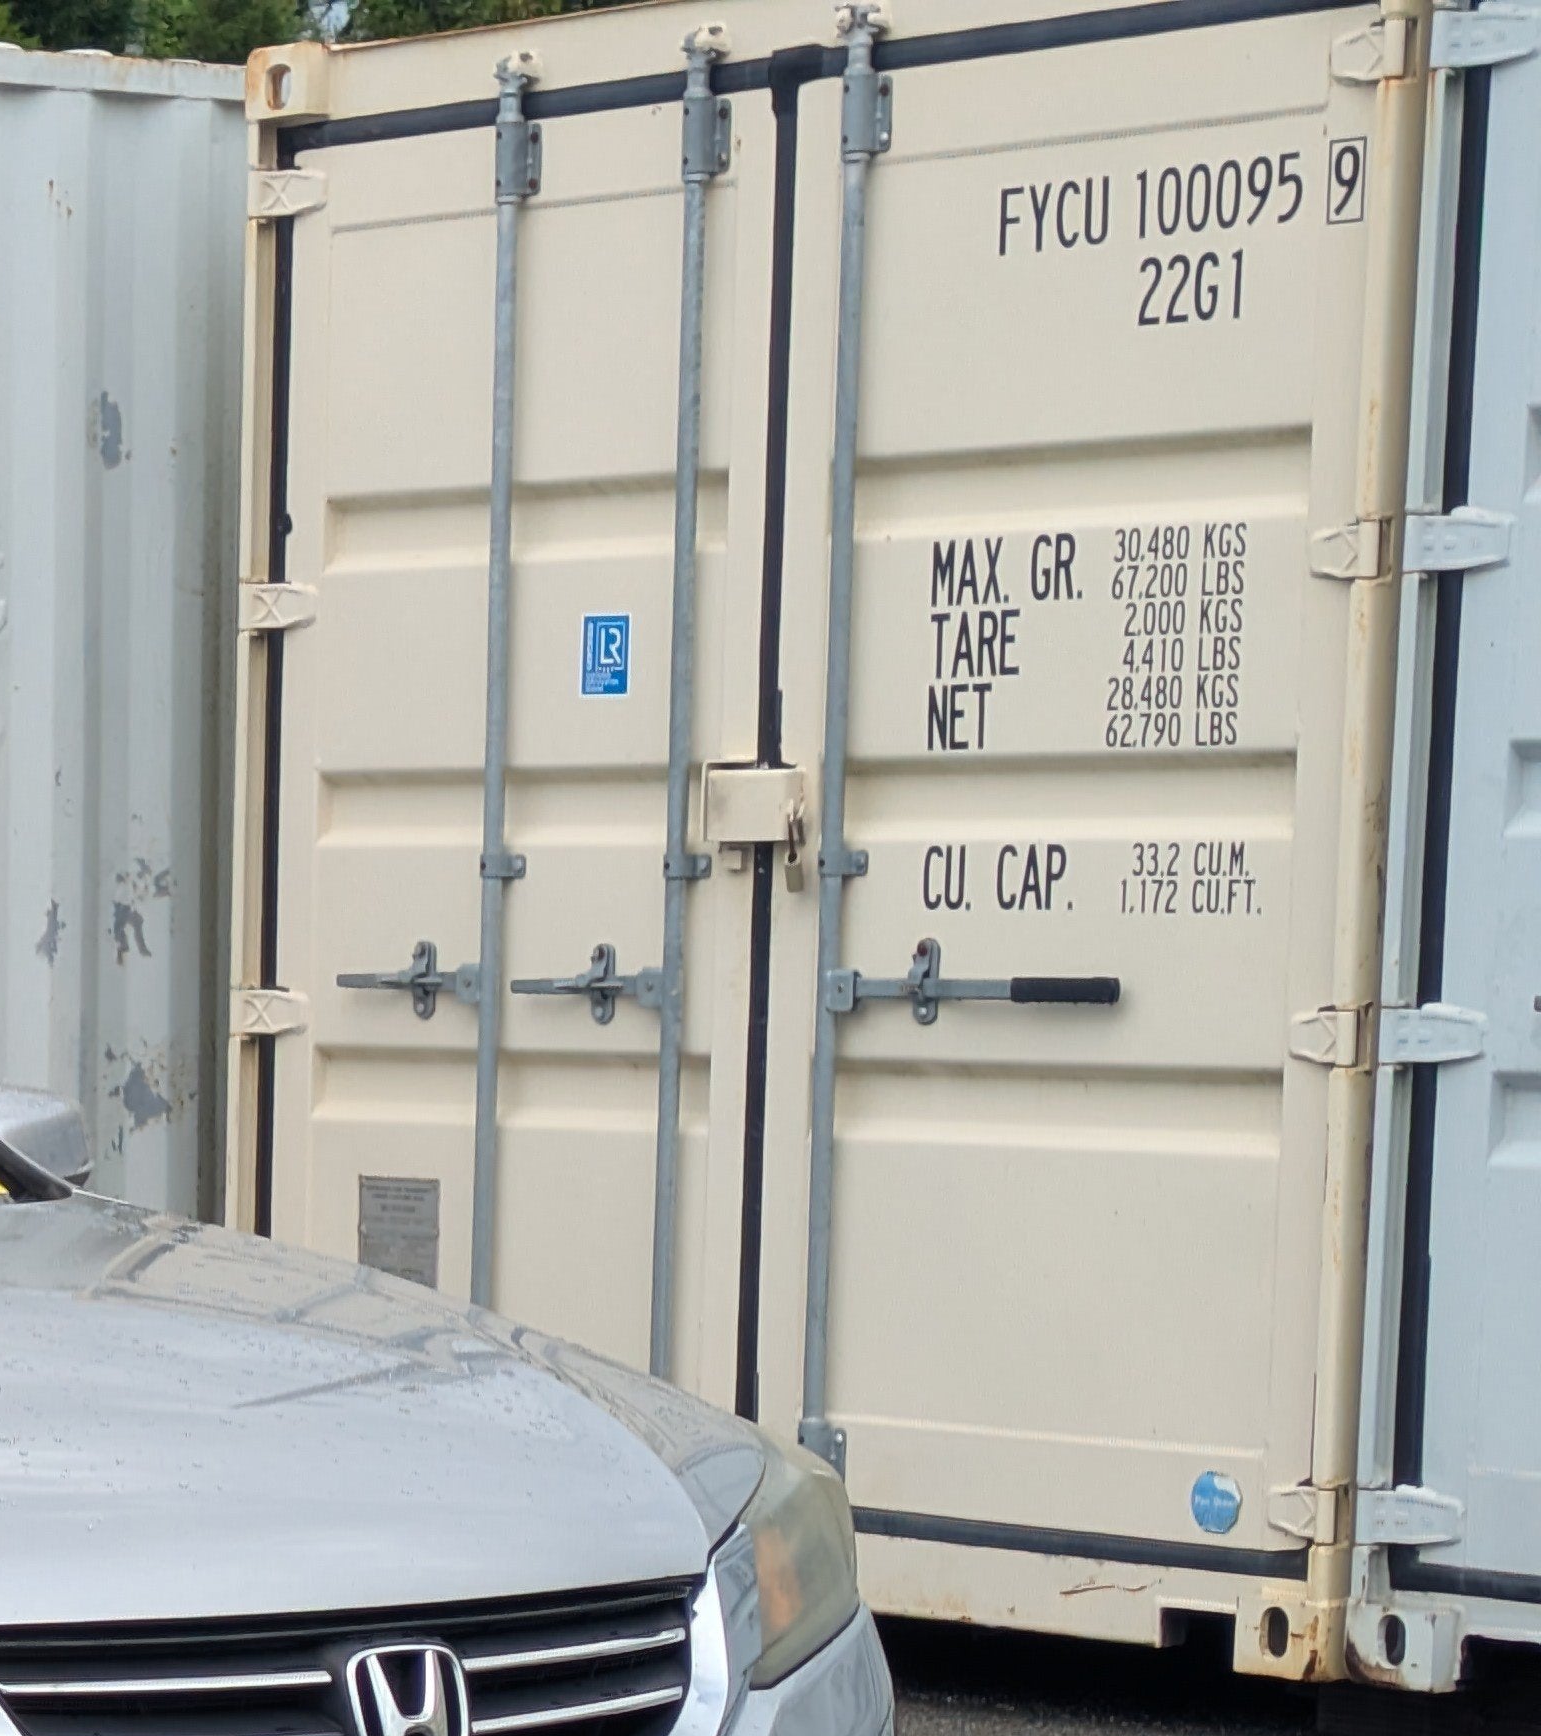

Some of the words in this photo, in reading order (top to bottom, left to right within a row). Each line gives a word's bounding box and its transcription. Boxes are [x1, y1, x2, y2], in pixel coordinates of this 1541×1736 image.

[997, 175, 1111, 256] FYCU
[1136, 151, 1304, 239] 1000095
[1334, 145, 1360, 216] 9
[1137, 249, 1244, 326] 22G1
[1203, 522, 1247, 559] KGS
[930, 536, 1010, 607] MAX.
[1030, 532, 1083, 600] GR.
[1201, 560, 1245, 596] LBS
[1199, 598, 1244, 634] KGS
[930, 608, 1021, 679] TARE
[1197, 635, 1241, 671] LBS
[1196, 673, 1239, 709] KGS
[927, 682, 993, 751] NET
[1194, 711, 1238, 746] LBS
[923, 844, 971, 911] CU.
[996, 843, 1073, 911] CAP.
[1132, 841, 1180, 877] 33.2
[1193, 840, 1250, 876] CU.M.
[1191, 878, 1262, 915] CU.FT.
